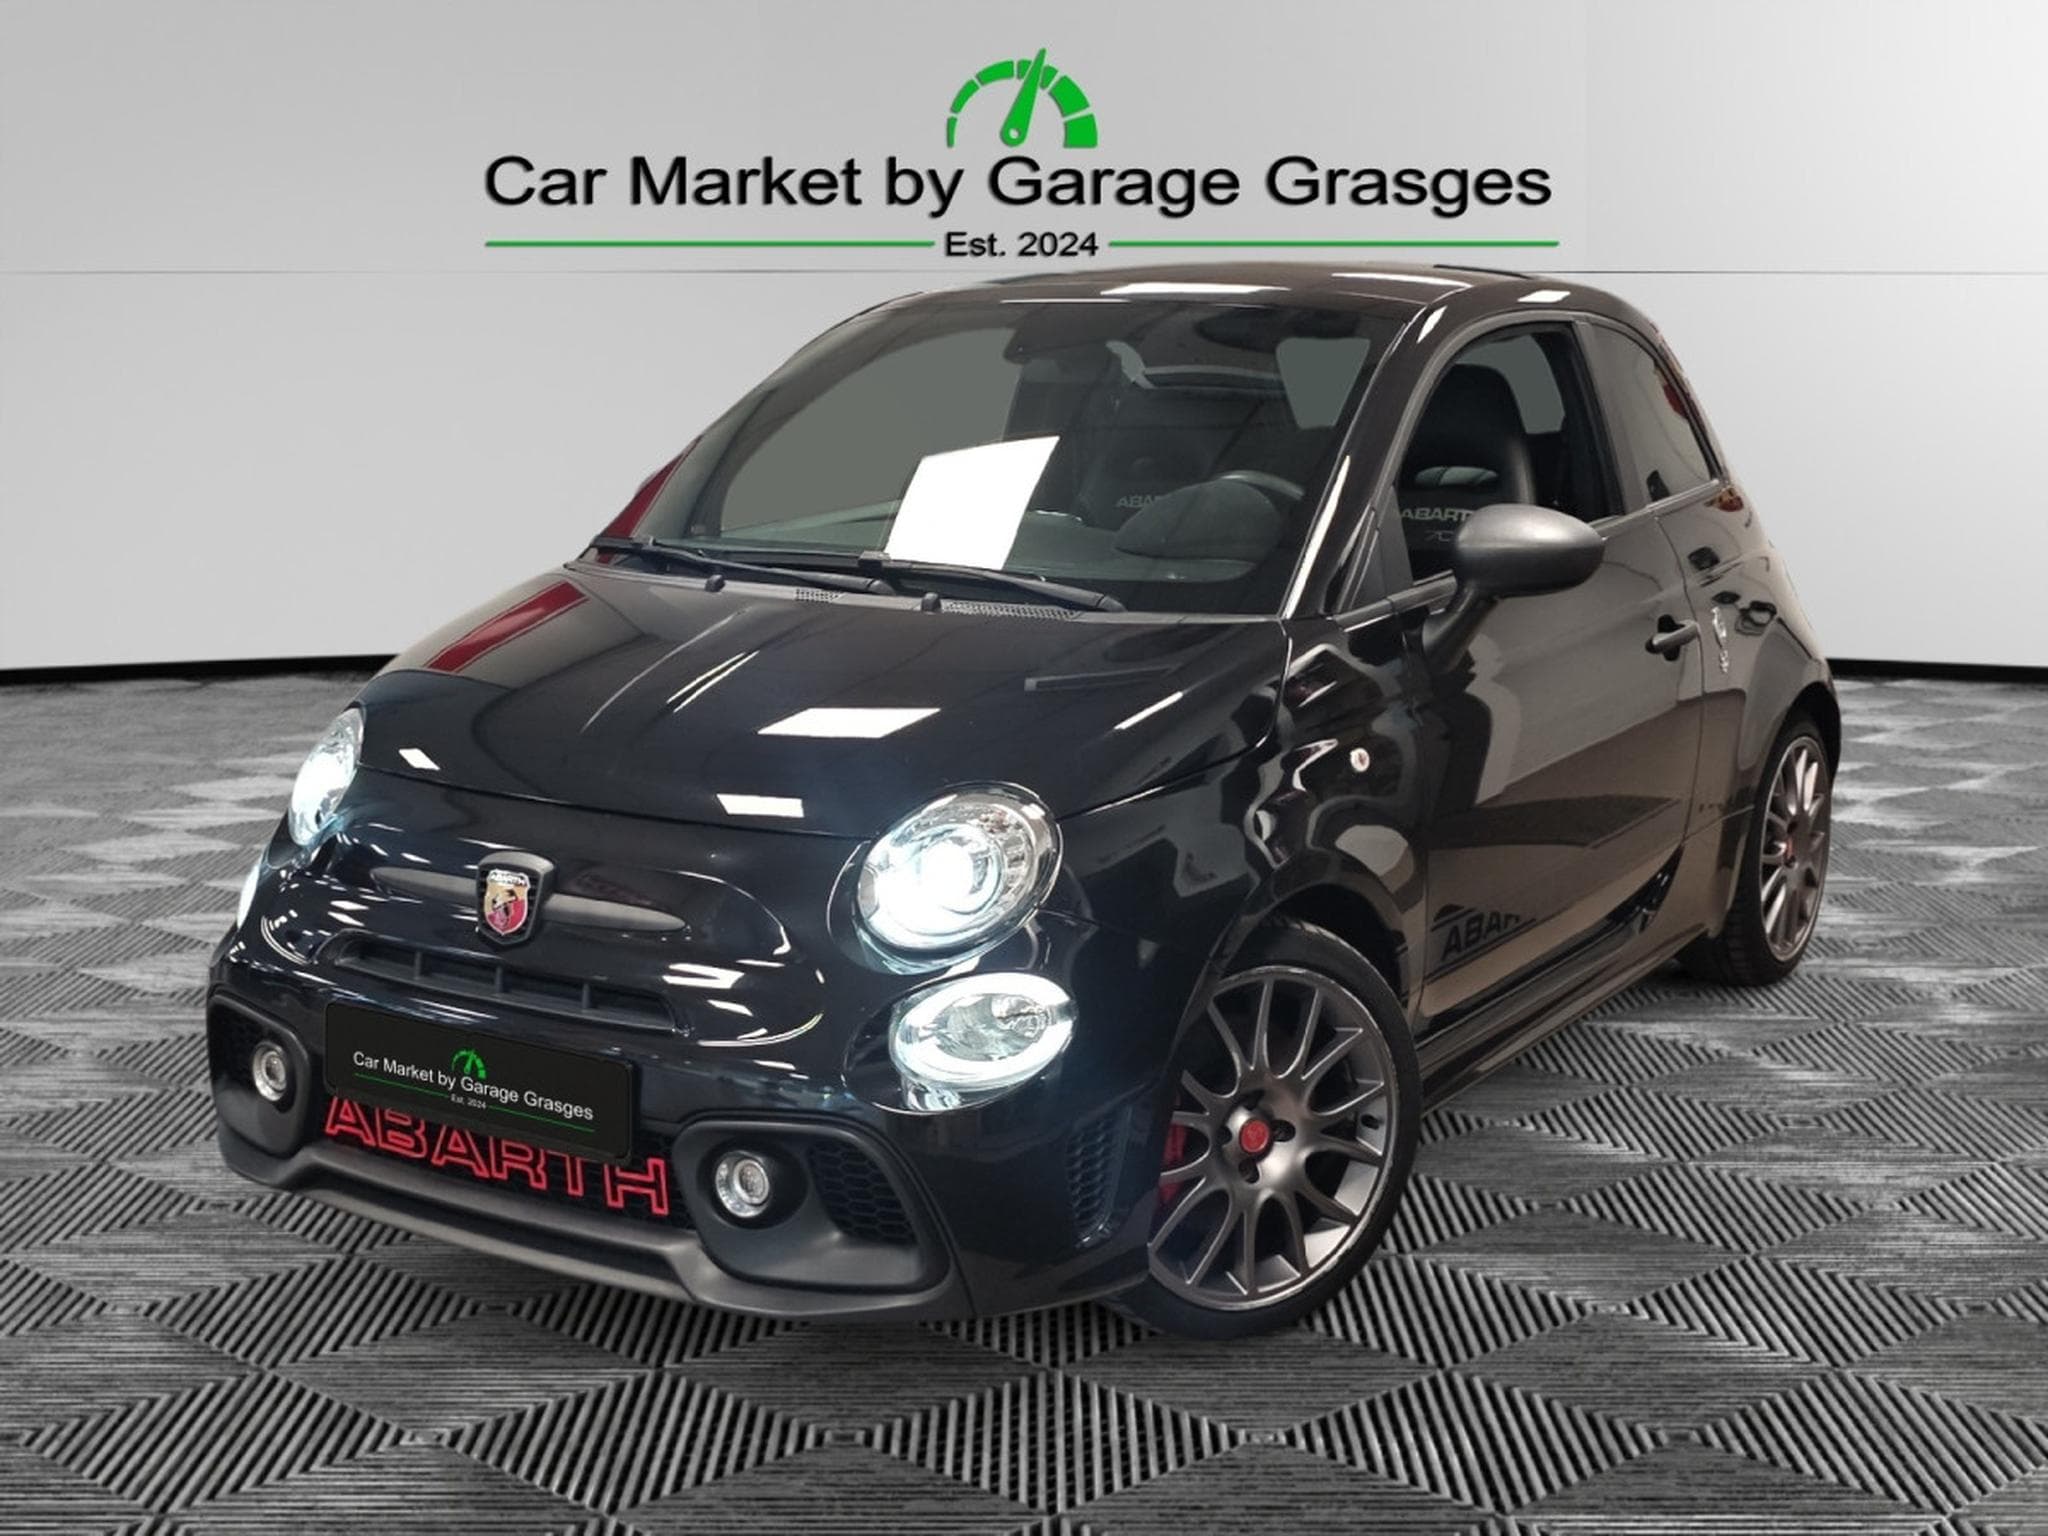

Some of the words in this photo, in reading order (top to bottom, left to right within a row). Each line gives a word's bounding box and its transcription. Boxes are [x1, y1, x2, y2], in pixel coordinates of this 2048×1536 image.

[353, 1051, 379, 1069] Car
[383, 1058, 434, 1083] Market
[438, 1070, 456, 1090] by
[460, 1076, 519, 1103] Garage
[523, 1091, 594, 1120] Grasges
[325, 1097, 670, 1216] ABARTH
